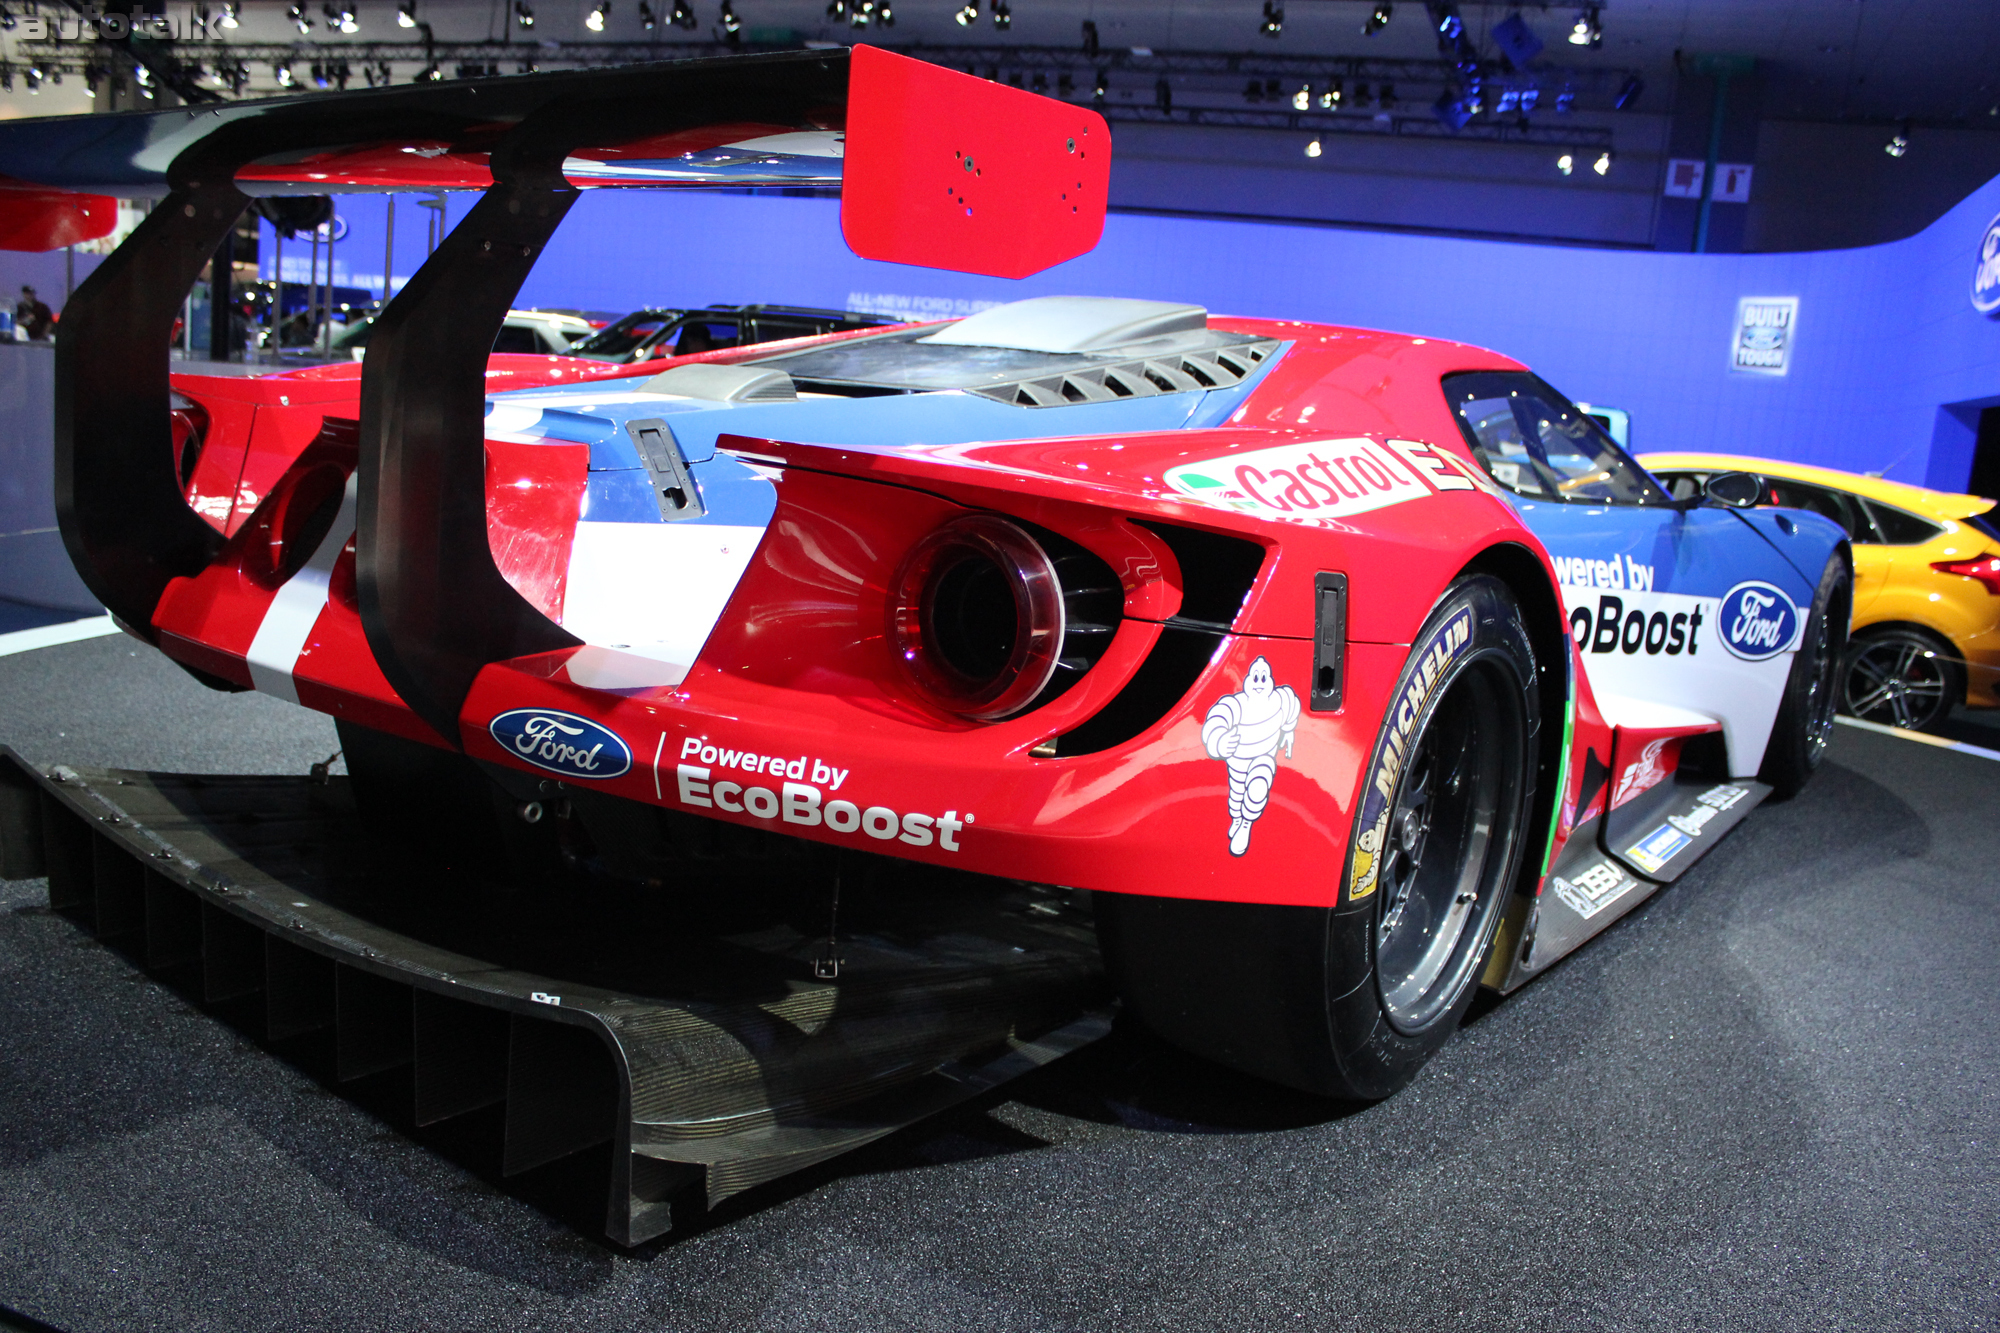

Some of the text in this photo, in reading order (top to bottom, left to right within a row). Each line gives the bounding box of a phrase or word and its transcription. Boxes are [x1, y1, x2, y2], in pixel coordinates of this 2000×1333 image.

[1975, 226, 2000, 294] For
[912, 295, 953, 313] FORD
[1744, 306, 1790, 327] BUILT
[1234, 446, 1412, 512] Castrol
[1549, 553, 1654, 592] wered by
[1731, 589, 1786, 649] Ford
[1375, 614, 1470, 800] MICHELIN
[514, 716, 605, 772] Ford
[680, 737, 849, 790] Powered by
